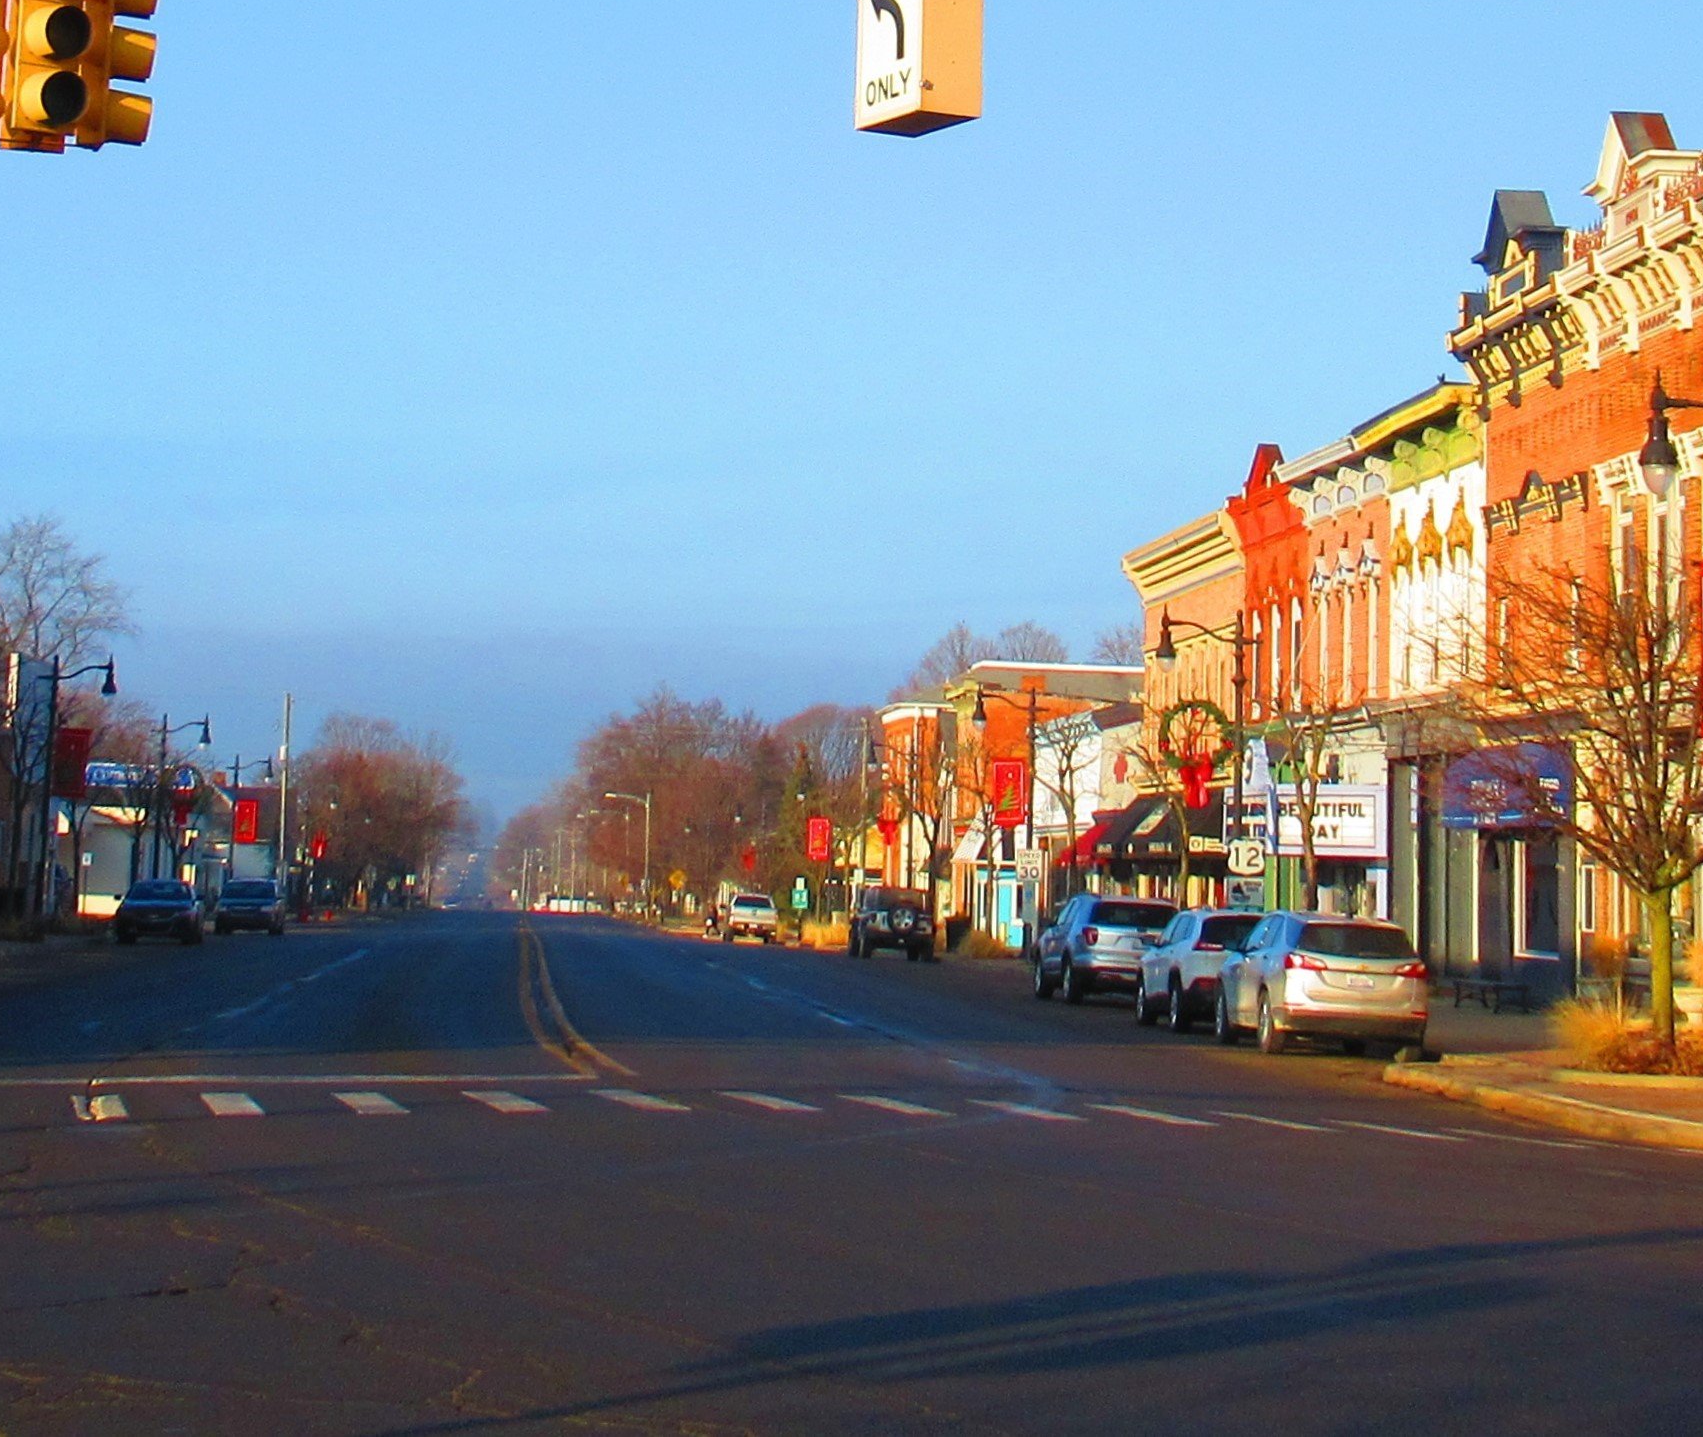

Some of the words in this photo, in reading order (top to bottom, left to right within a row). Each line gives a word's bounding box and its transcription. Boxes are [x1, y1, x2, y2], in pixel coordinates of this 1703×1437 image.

[865, 67, 912, 107] ONLY
[1278, 802, 1366, 818] BEUTIFUL
[1233, 847, 1261, 868] 12
[1019, 865, 1040, 879] 30
